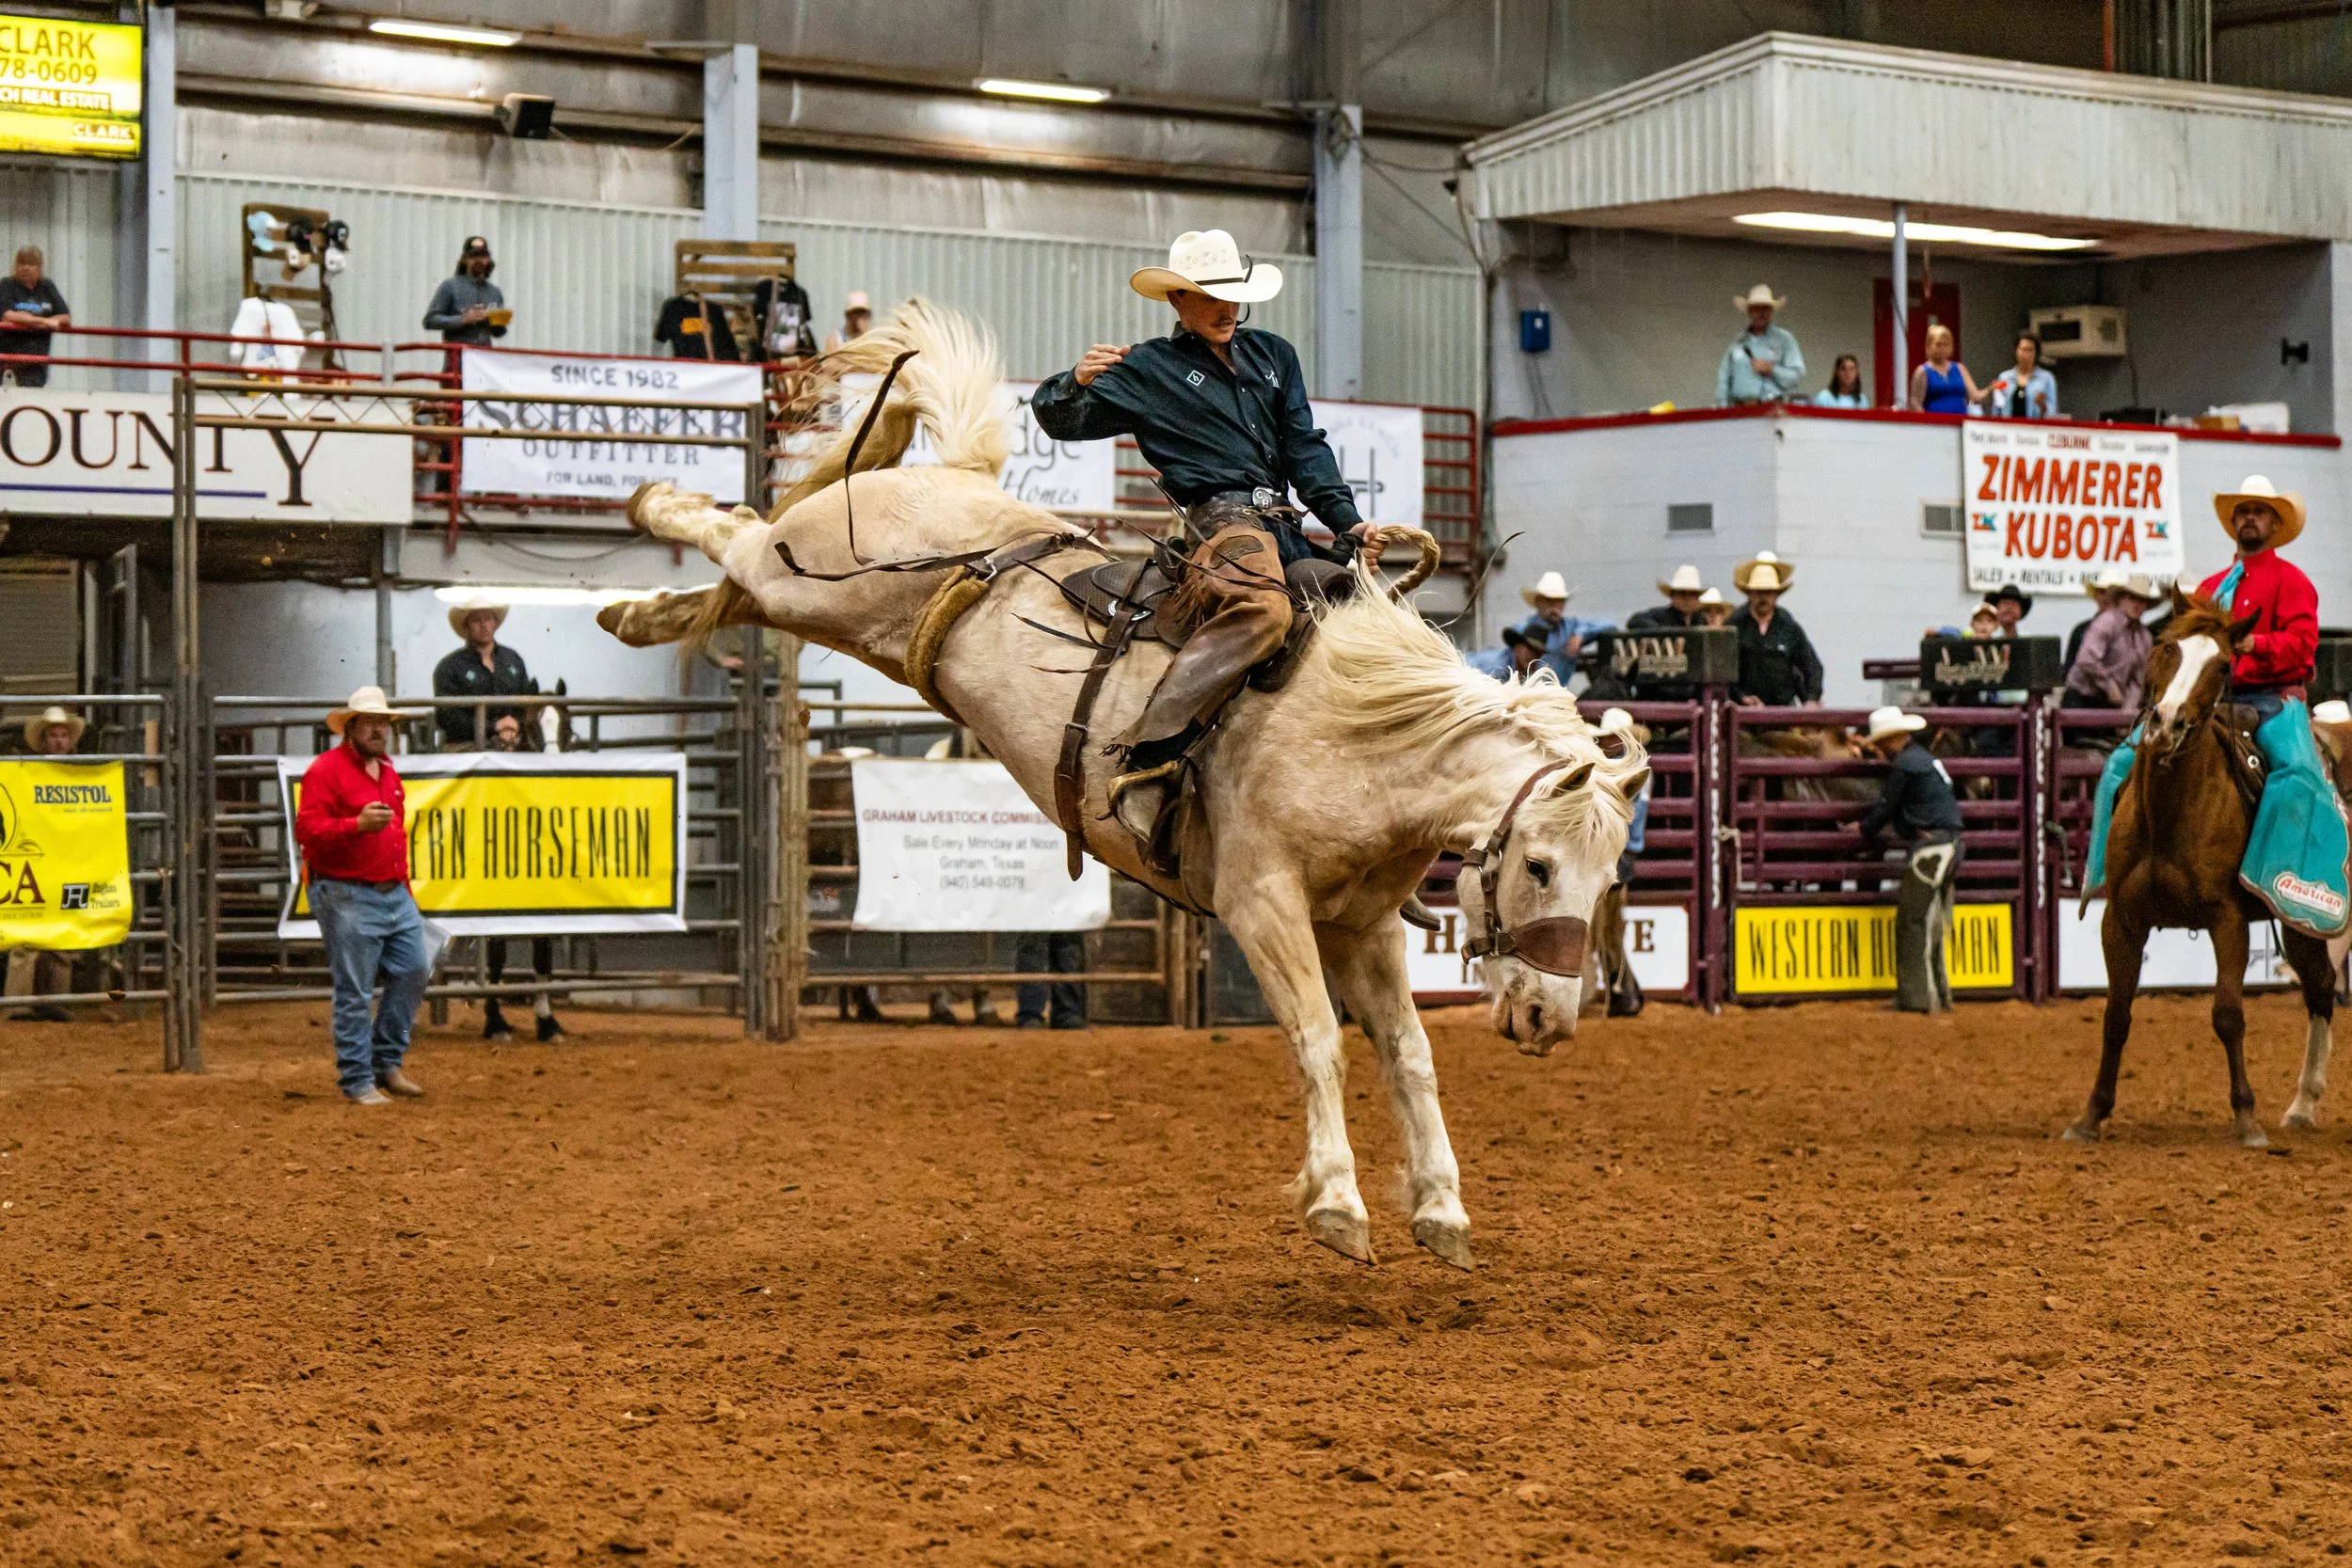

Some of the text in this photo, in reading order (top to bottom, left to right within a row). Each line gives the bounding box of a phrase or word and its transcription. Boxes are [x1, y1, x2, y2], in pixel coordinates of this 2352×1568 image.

[0, 24, 95, 59] CLARK
[21, 87, 57, 106] REAL
[58, 91, 110, 109] ESTATE
[73, 122, 134, 139] CLARK
[551, 365, 679, 389] SINCE 1982
[523, 437, 701, 466] OUTFITTER
[546, 471, 571, 483] FOR
[576, 473, 616, 486] LAND,
[1978, 453, 2163, 509] ZIMMERER
[2004, 511, 2138, 562] KUBOTA
[34, 785, 112, 804] RESISTOL
[862, 809, 916, 823] GRAHAM
[918, 810, 987, 824] LIVESTOCK
[483, 804, 652, 880] HORSEMAN
[903, 834, 1058, 851] Sale Every Monday at Noon
[993, 855, 1024, 869] Texas
[1749, 915, 2000, 980] WESTERN HOMAN
